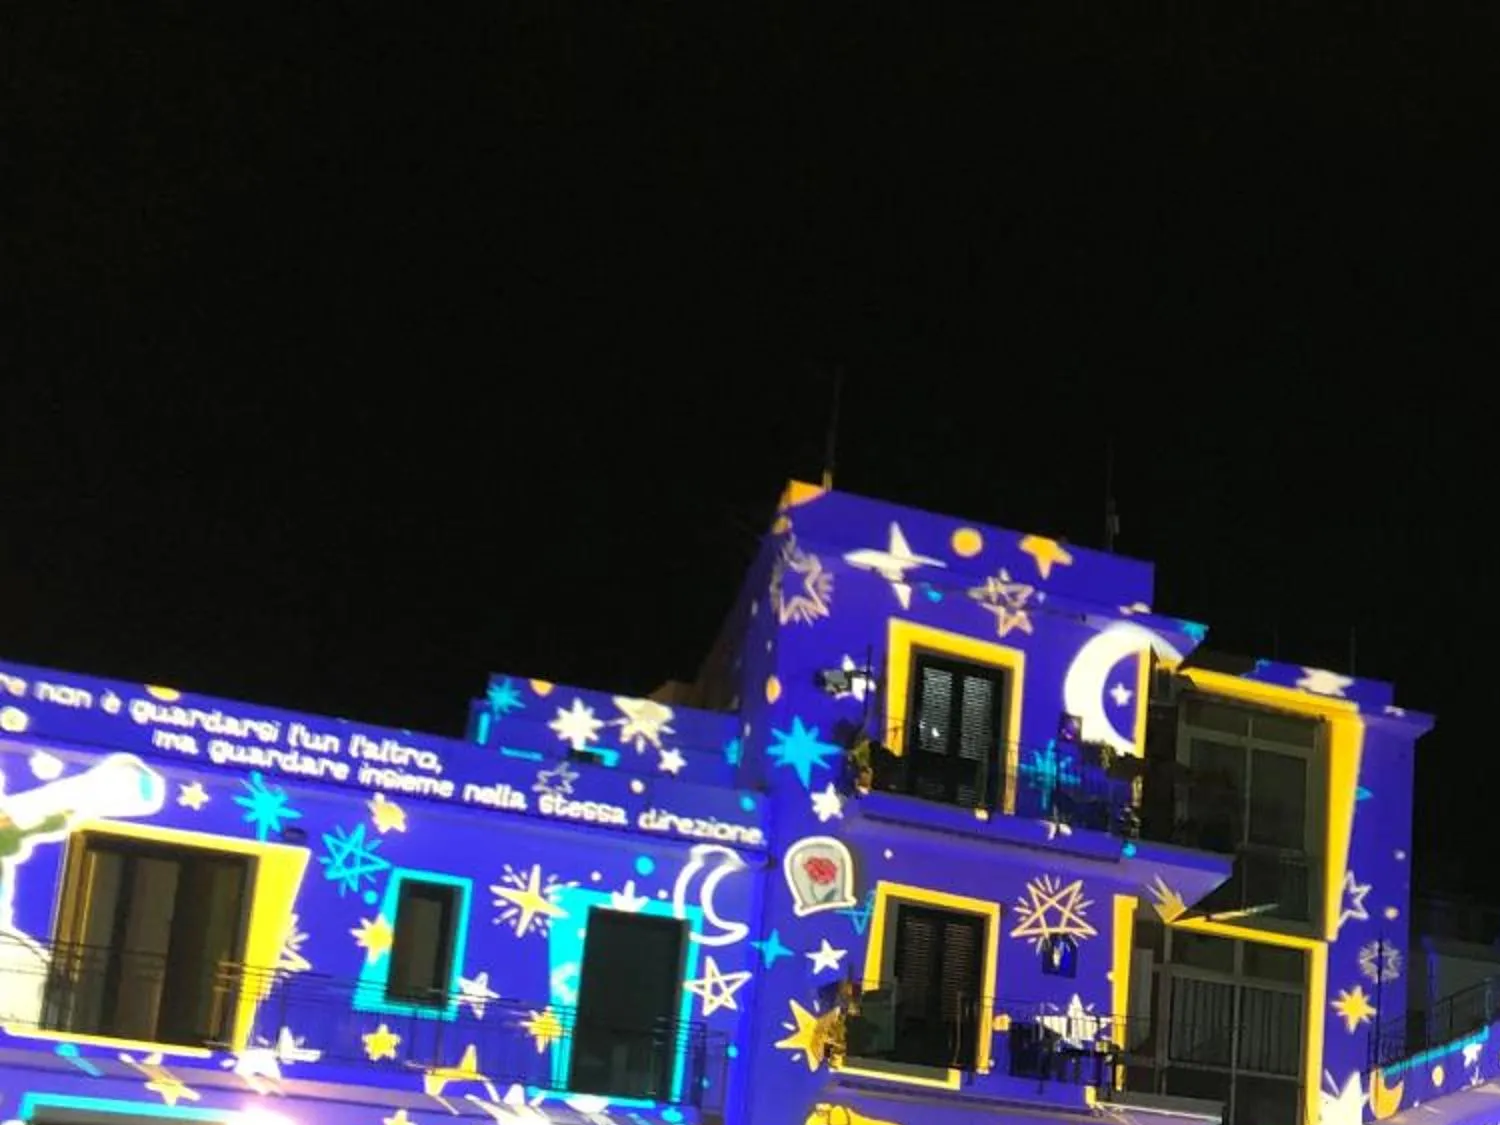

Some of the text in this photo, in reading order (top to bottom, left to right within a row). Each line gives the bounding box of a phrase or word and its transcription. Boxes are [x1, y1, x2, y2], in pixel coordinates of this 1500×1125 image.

[34, 680, 93, 710] non
[151, 729, 199, 756] ma
[207, 739, 351, 781] guardare
[357, 760, 455, 798] insieme
[463, 783, 528, 812] nella
[538, 793, 629, 826] stessa
